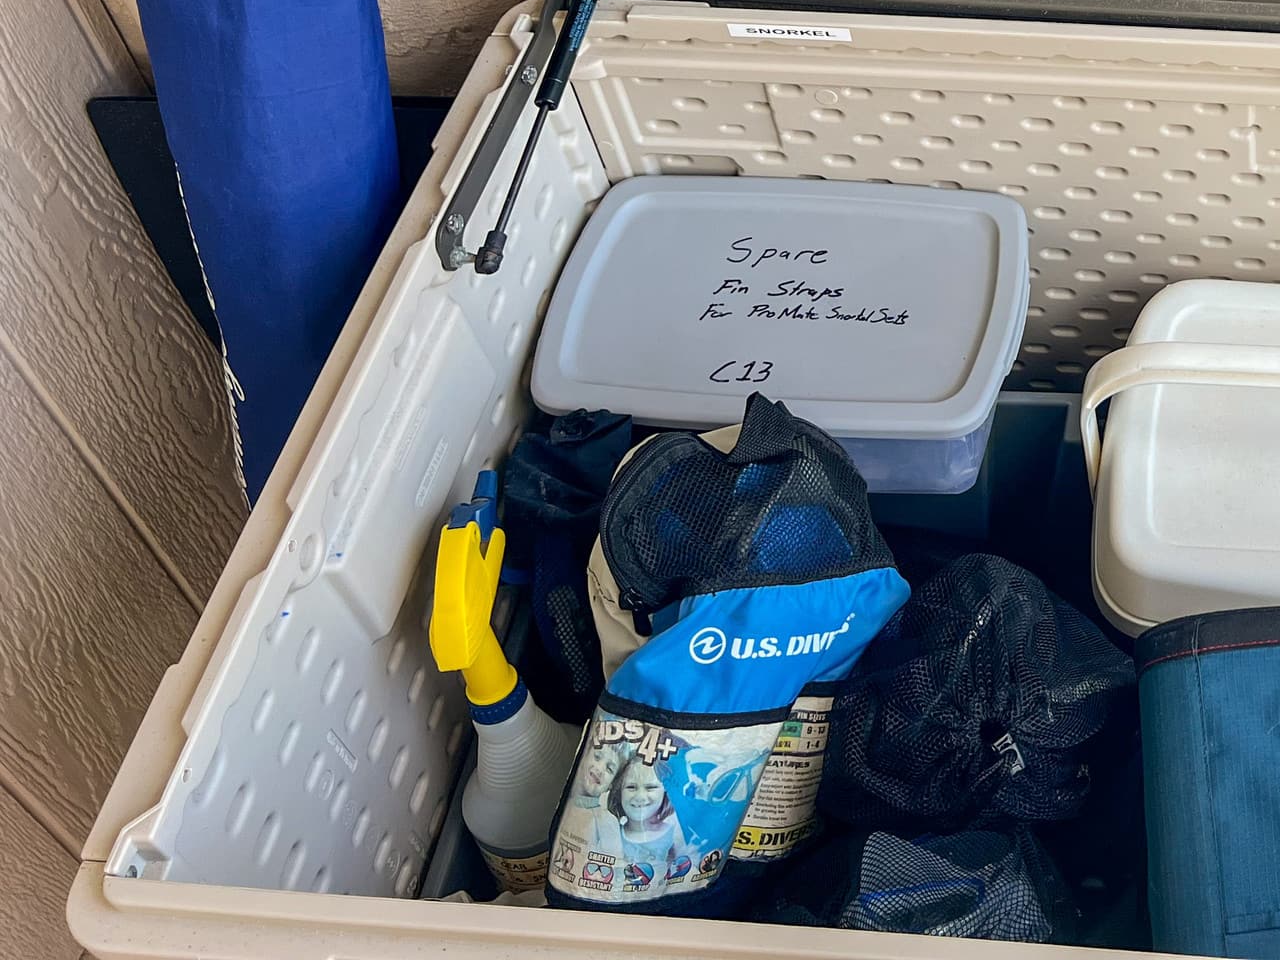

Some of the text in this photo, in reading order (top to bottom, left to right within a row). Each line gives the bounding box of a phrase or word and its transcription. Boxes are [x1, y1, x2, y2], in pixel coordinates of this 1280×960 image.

[745, 27, 837, 38] SNORKEL
[726, 237, 828, 268] Spare
[713, 279, 844, 302] Fin Straps
[699, 303, 733, 321] For
[709, 360, 774, 383] C13
[731, 631, 836, 661] U.S. DIV
[638, 728, 678, 765] 4+
[768, 760, 810, 769] EATURES
[734, 830, 755, 846] .S.
